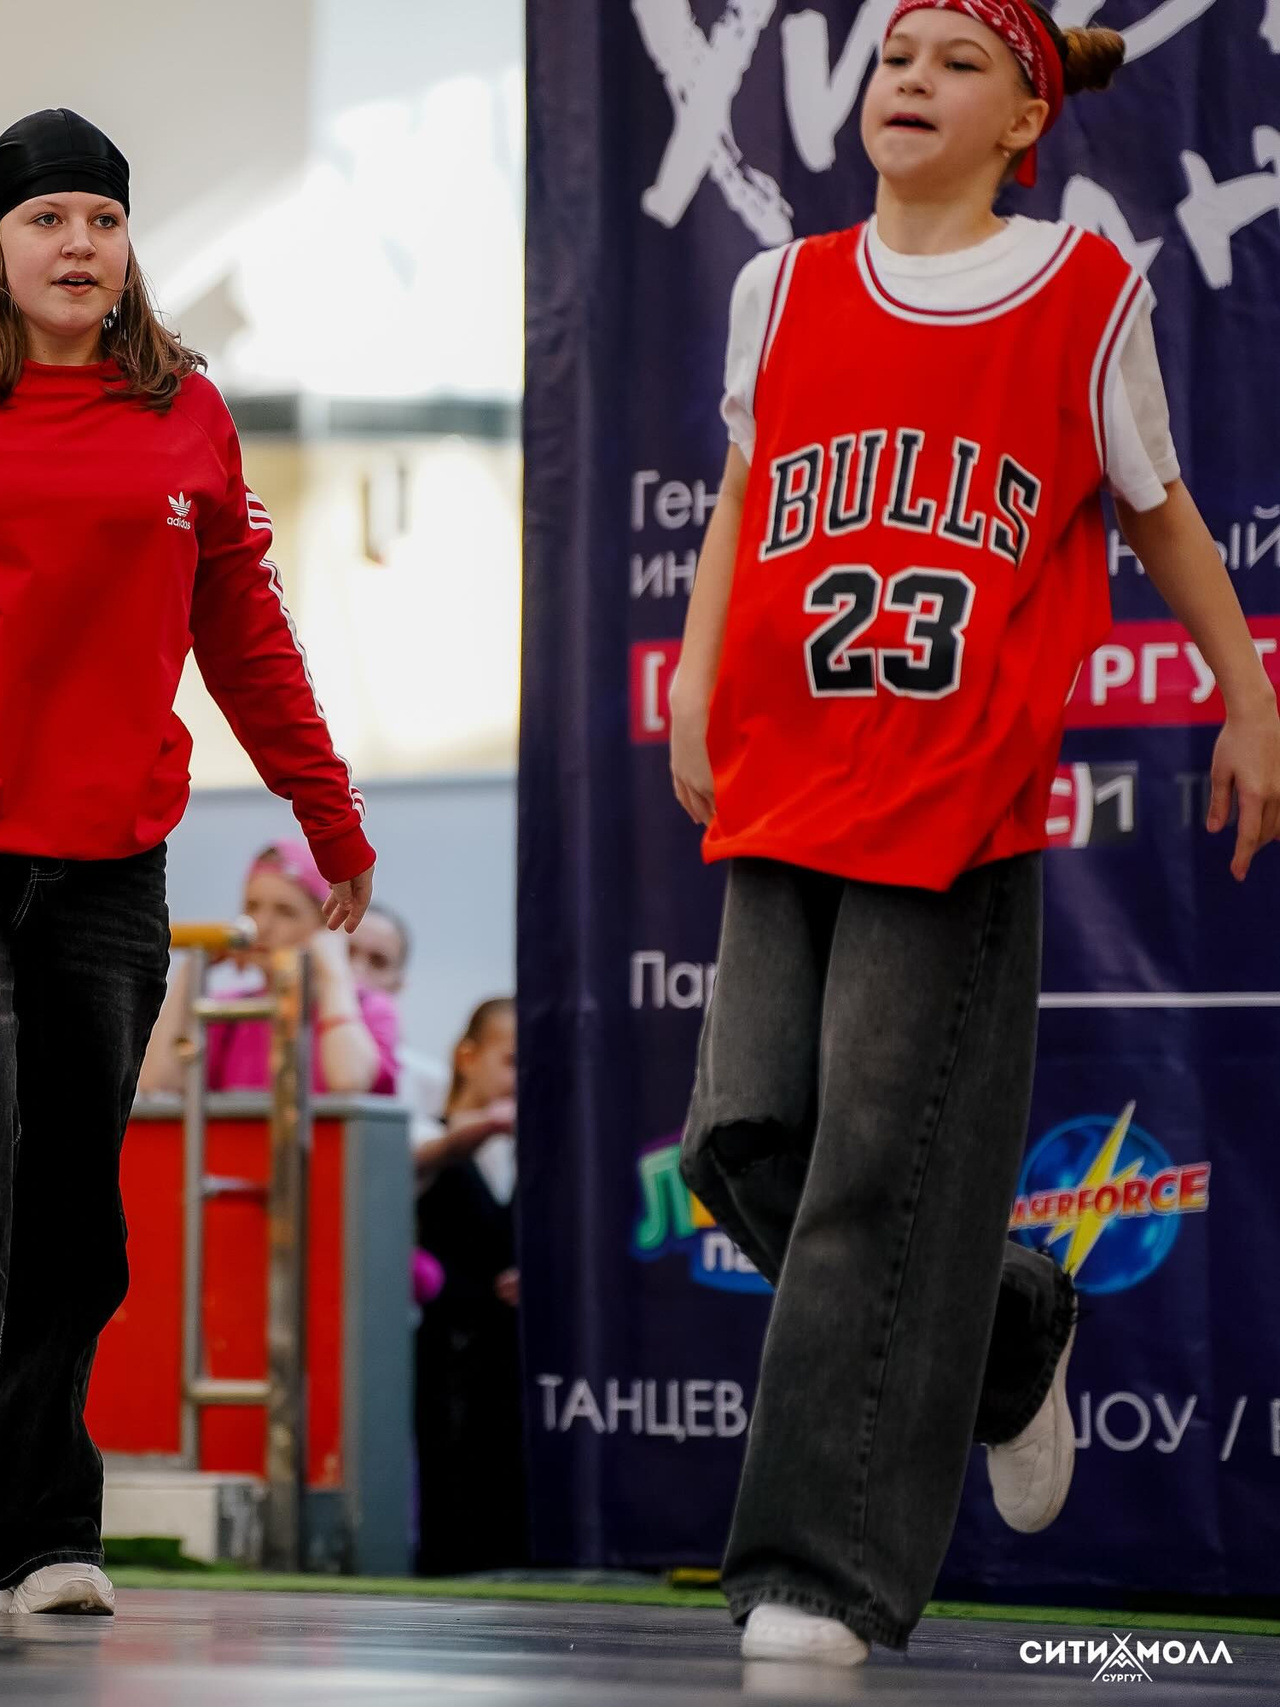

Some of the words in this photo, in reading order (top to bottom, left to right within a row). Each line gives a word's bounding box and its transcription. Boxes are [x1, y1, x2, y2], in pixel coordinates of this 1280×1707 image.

[166, 516, 191, 530] adidas
[758, 427, 1042, 568] BULLS
[803, 563, 977, 700] 23
[1008, 1160, 1212, 1232] ASERFORCE
